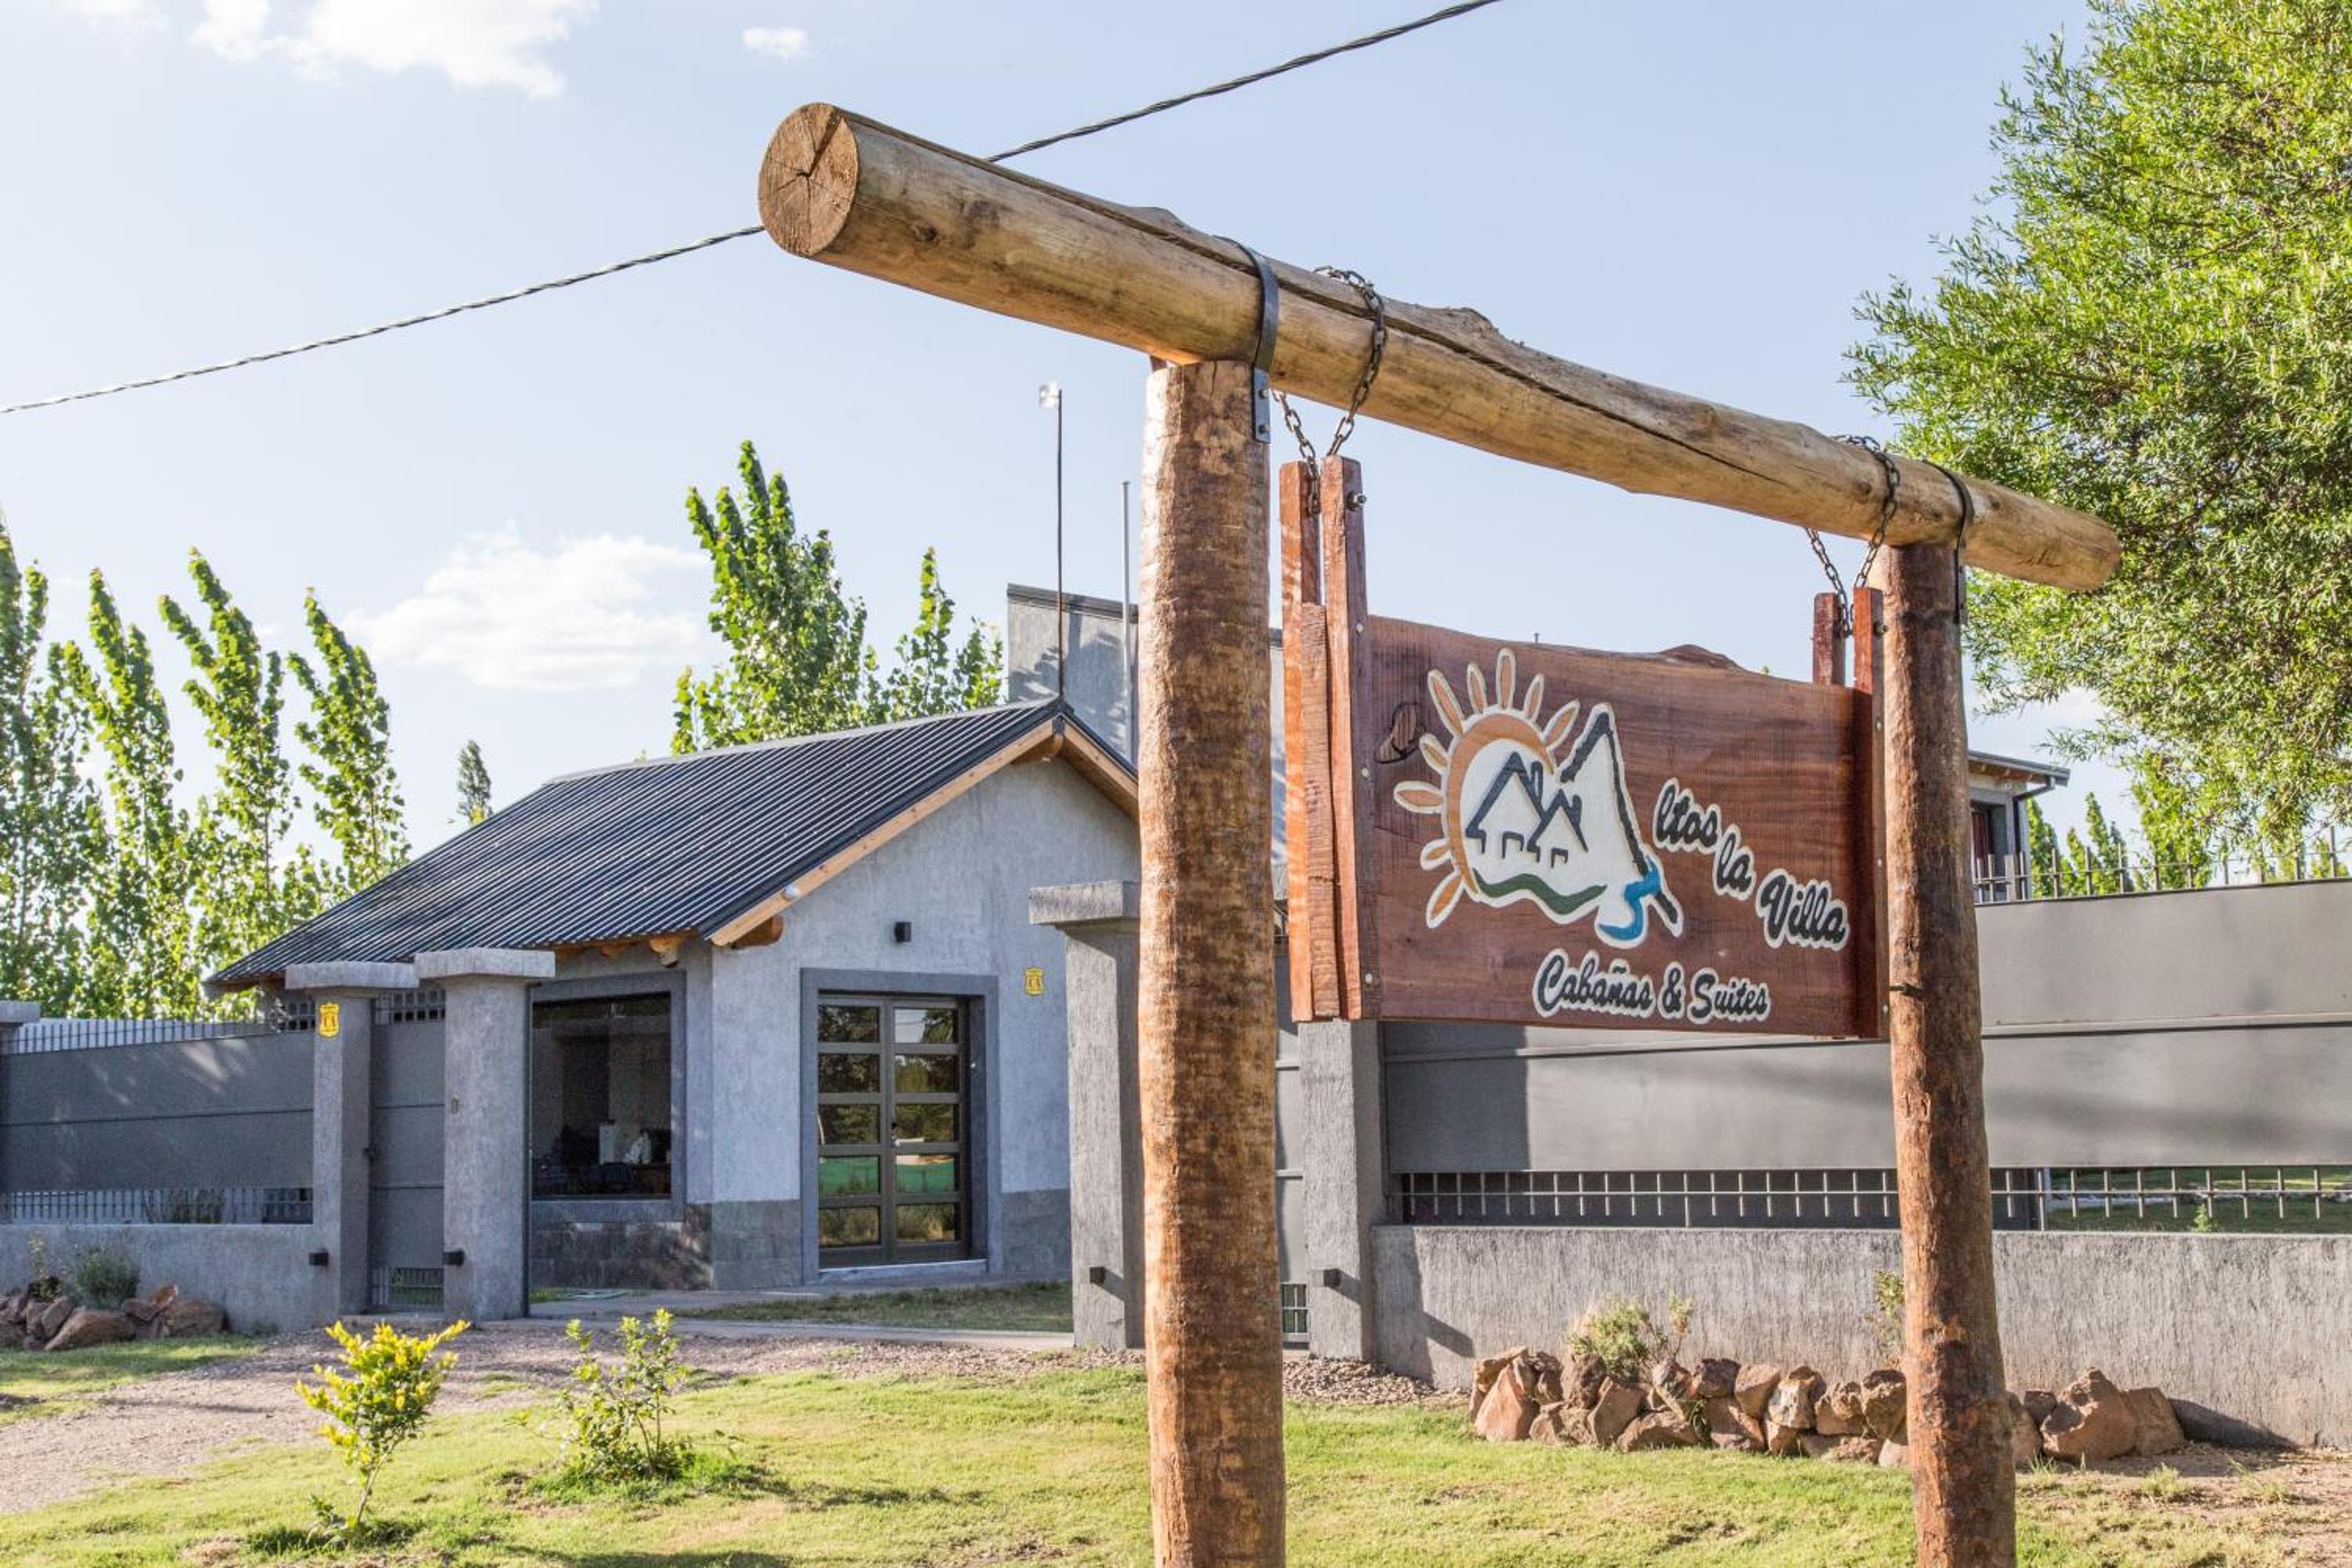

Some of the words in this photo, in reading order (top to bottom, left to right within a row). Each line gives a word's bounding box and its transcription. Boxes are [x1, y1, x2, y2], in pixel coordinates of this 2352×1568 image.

[1715, 829, 1753, 895] la
[1759, 871, 1847, 946] Villa
[1535, 952, 1654, 1013] Cabañas
[1661, 965, 1683, 1014] &
[1690, 971, 1769, 1020] Suites
